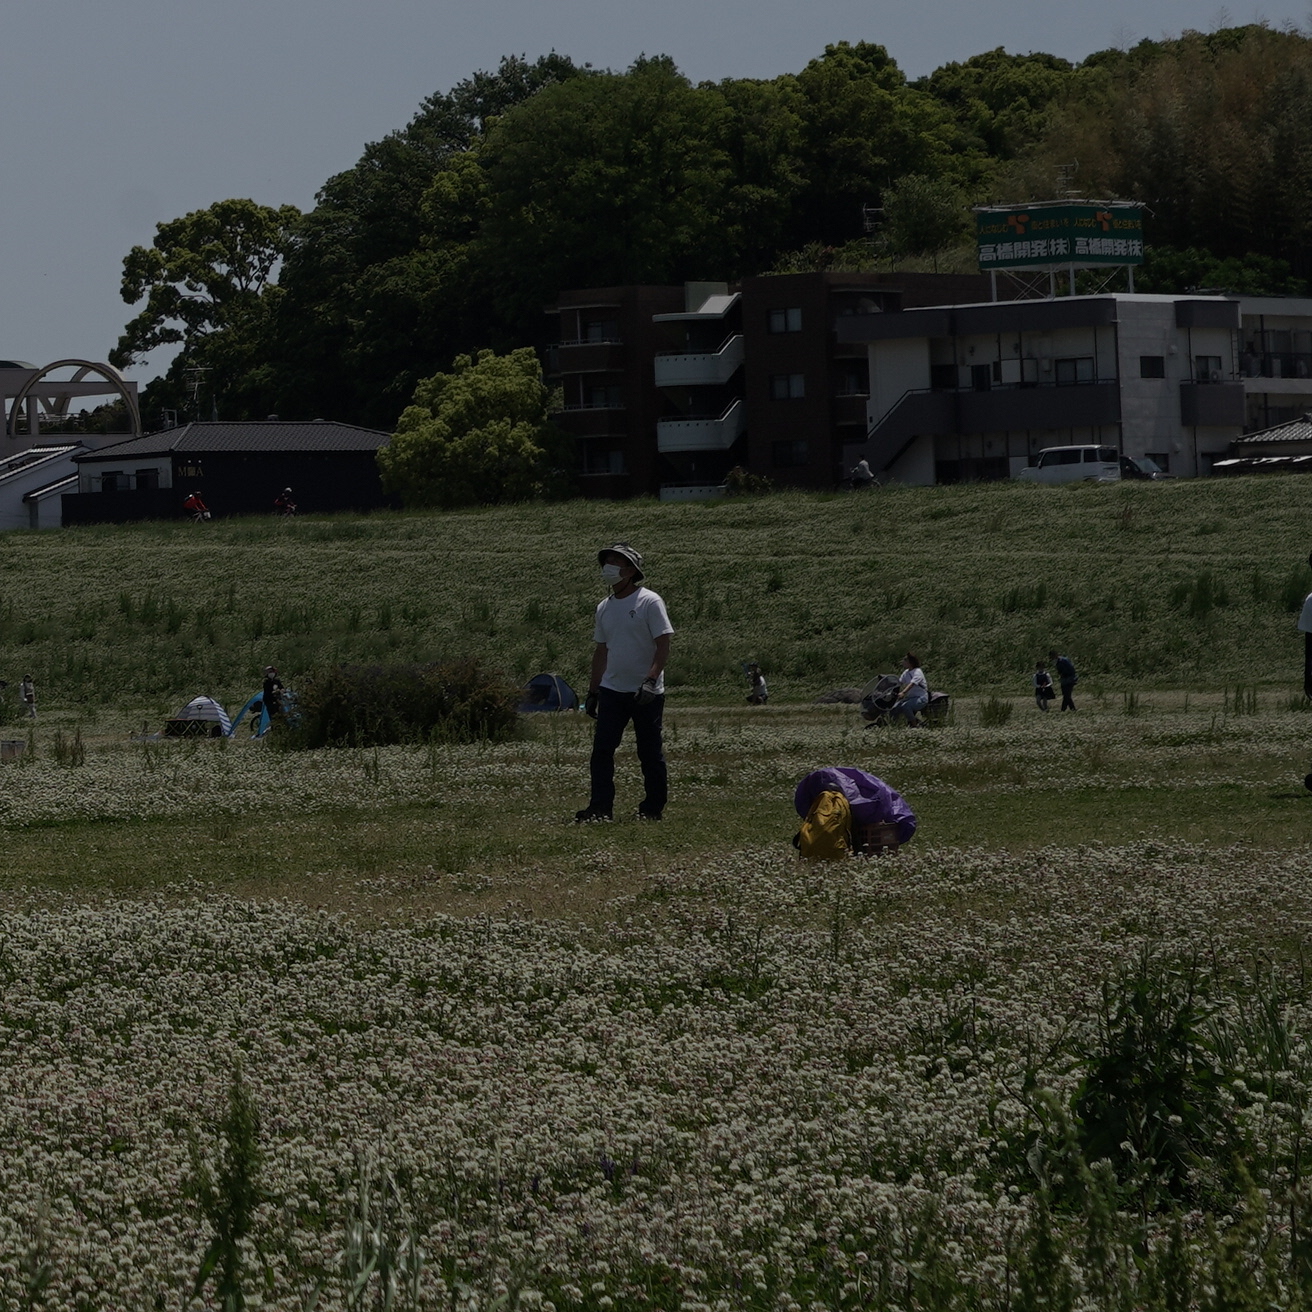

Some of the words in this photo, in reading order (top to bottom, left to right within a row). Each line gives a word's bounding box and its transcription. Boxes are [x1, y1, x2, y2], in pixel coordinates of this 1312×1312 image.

[979, 238, 1070, 261] 高橋開発(株)
